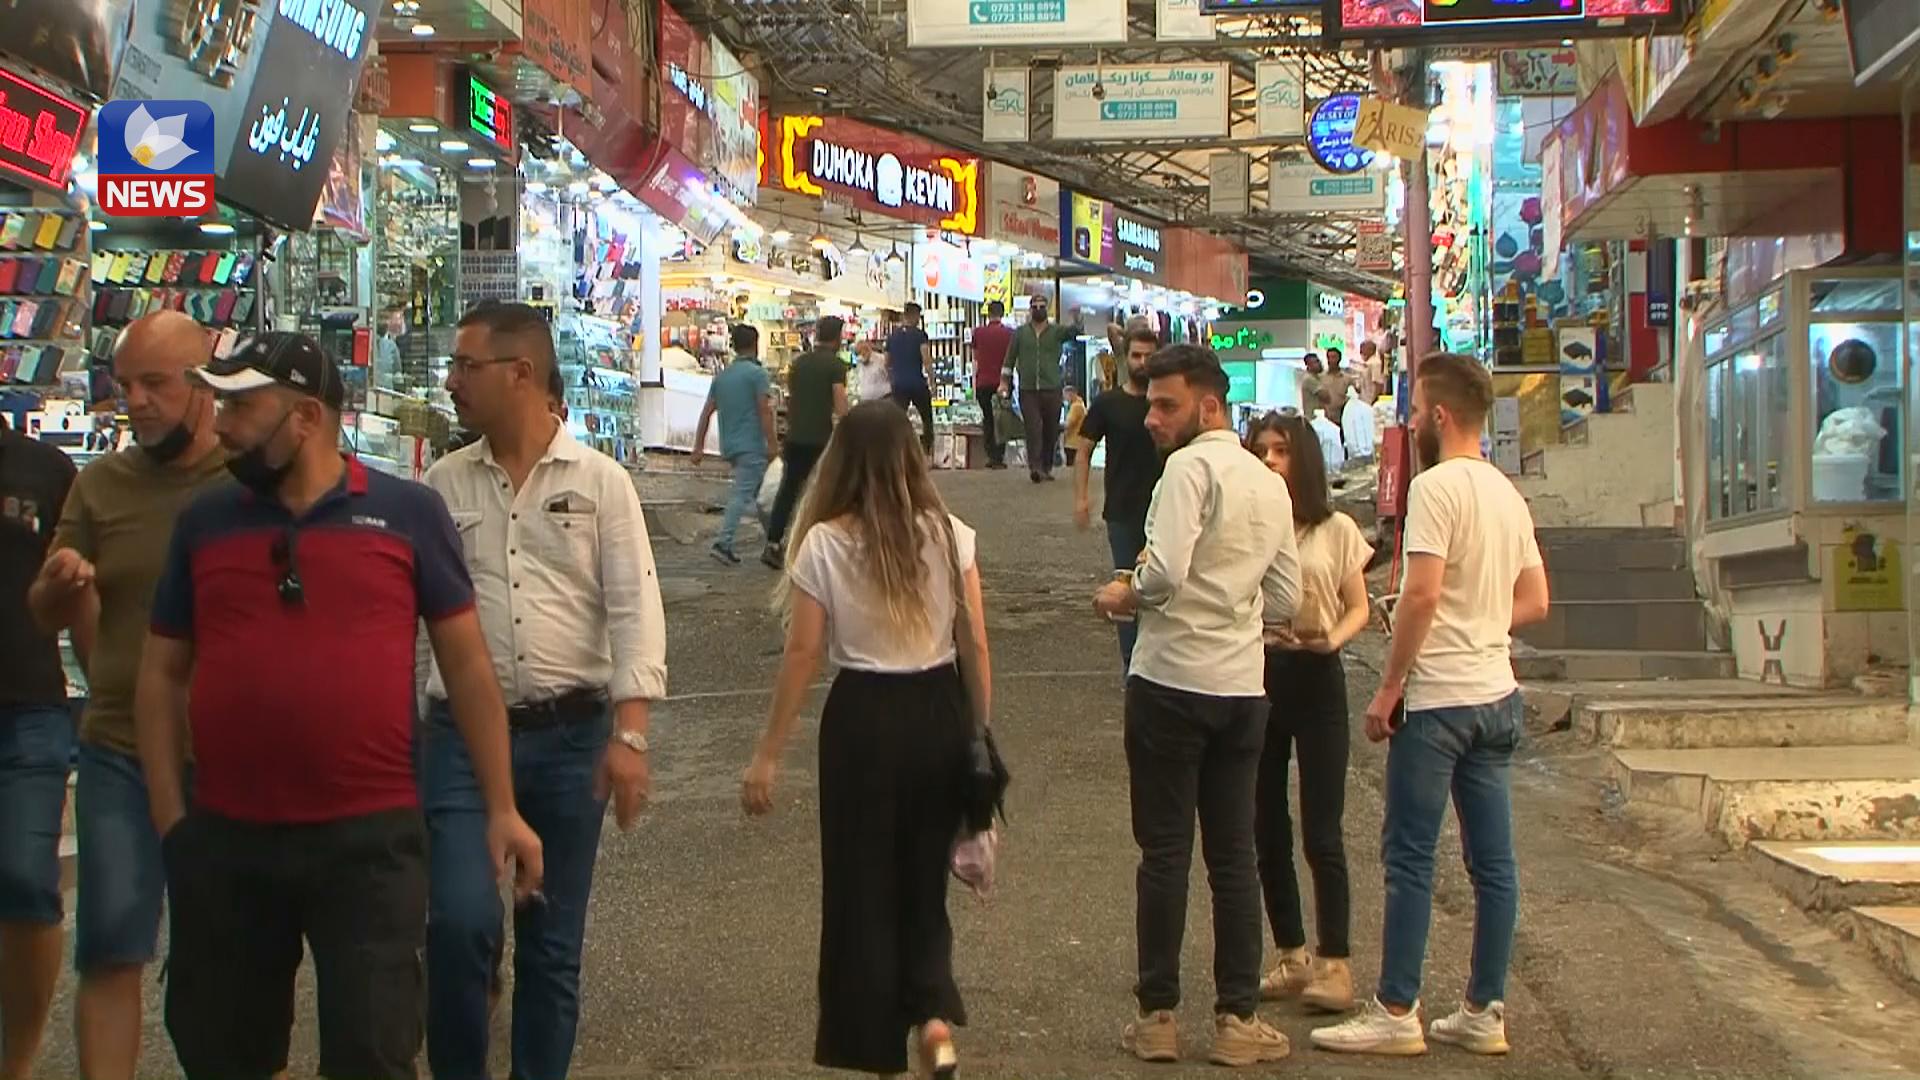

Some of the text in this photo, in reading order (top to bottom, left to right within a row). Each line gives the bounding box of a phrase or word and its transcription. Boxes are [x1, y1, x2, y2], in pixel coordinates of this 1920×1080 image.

[813, 139, 874, 192] DUHOKA
[905, 164, 953, 212] KEVIN
[1117, 216, 1161, 252] SAMSUNG
[1319, 291, 1344, 316] oppo
